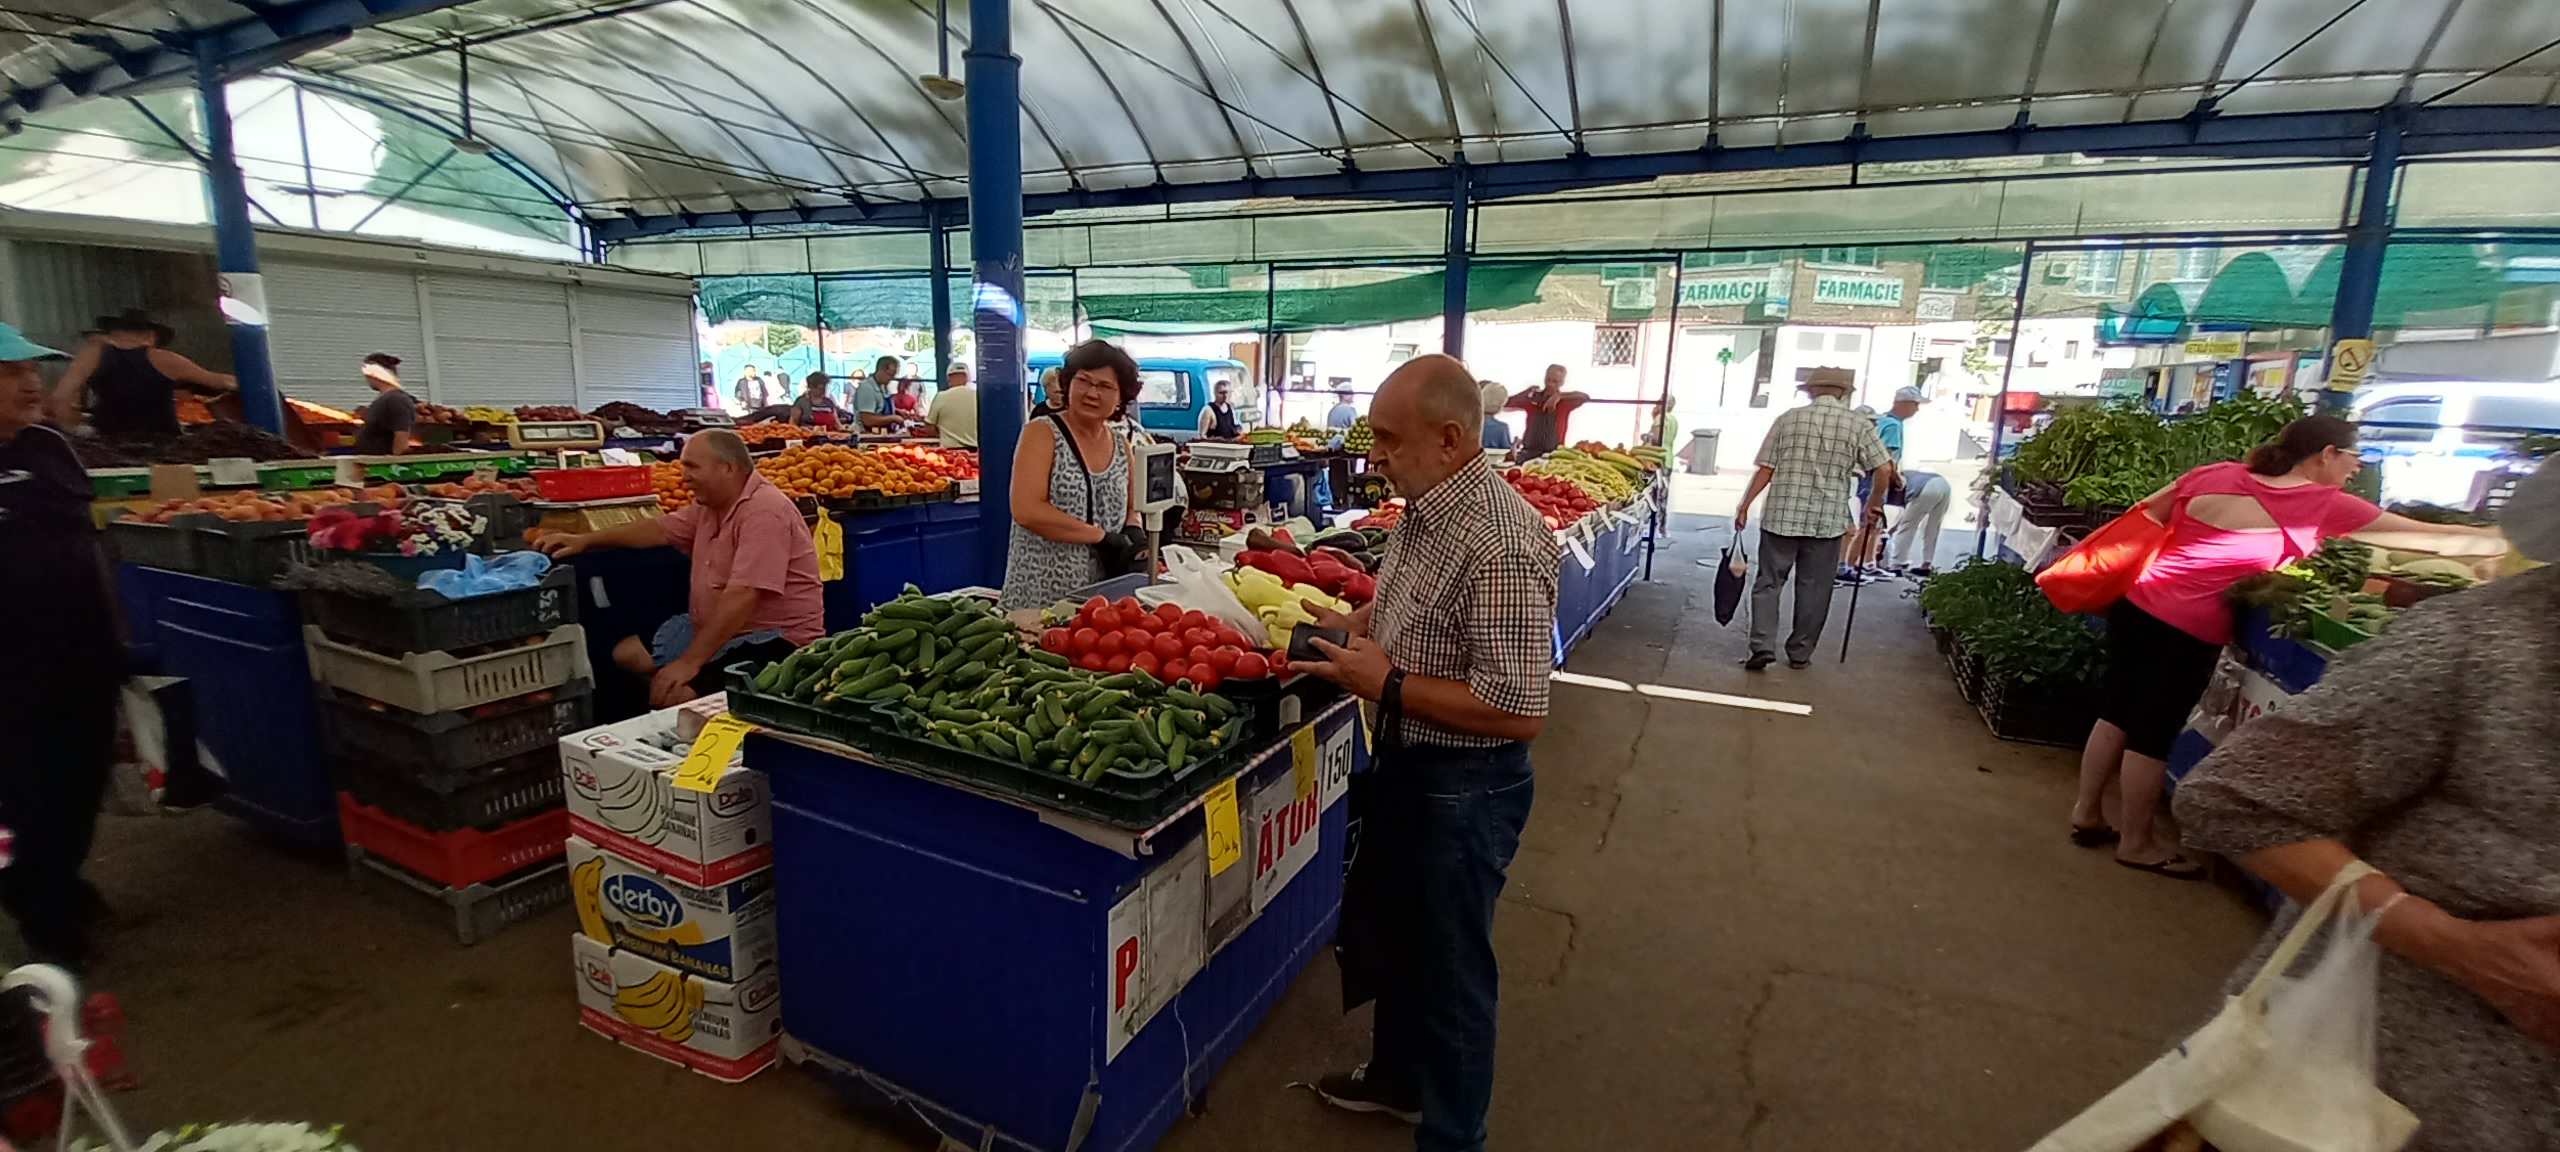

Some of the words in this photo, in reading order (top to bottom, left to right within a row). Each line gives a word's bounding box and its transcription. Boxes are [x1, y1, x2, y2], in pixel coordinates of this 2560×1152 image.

[1817, 278, 1901, 302] FARMACIE
[678, 732, 719, 777] 3
[1326, 737, 1350, 792] 150
[573, 766, 598, 791] Dole
[718, 785, 755, 811] Dole
[1207, 805, 1225, 861] 5
[607, 875, 678, 927] derby
[587, 962, 613, 986] Dole
[672, 953, 730, 978] BANANAS
